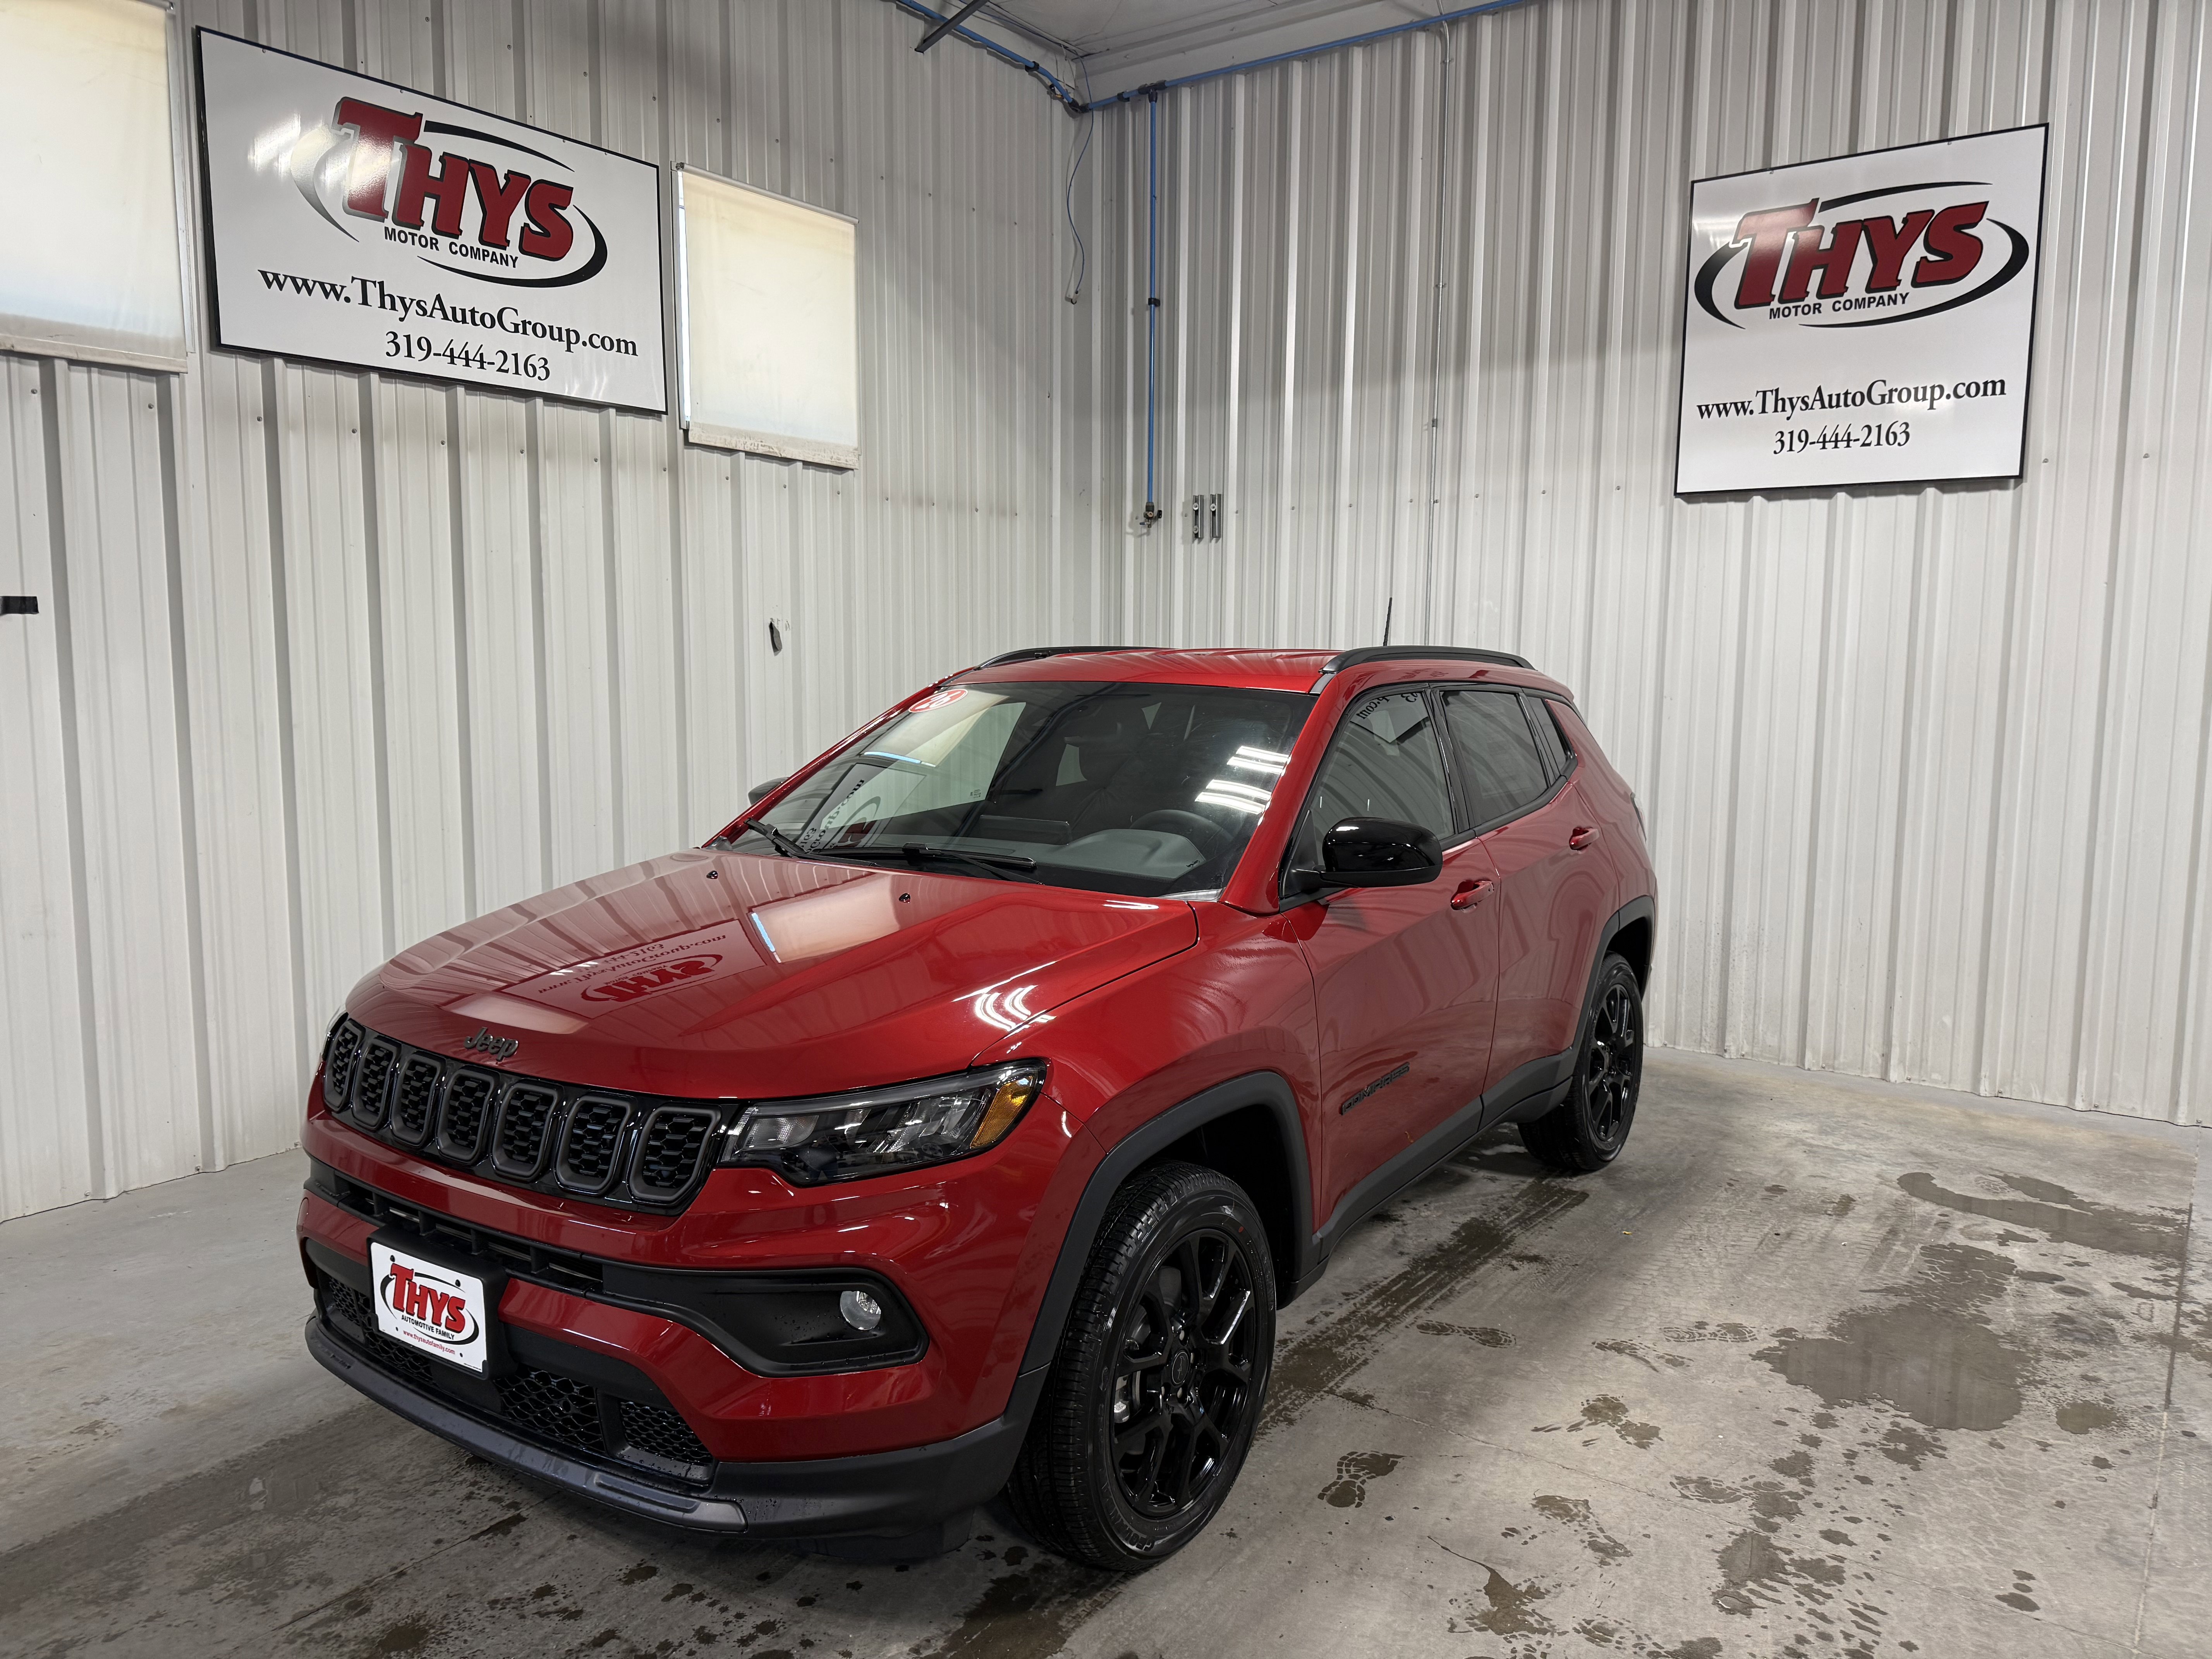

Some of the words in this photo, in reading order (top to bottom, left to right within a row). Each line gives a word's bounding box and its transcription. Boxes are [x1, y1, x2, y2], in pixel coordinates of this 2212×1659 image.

[331, 96, 574, 262] THYS
[384, 226, 439, 251] MOTOR
[449, 241, 519, 269] COMPANY
[1734, 197, 1989, 310] THYS
[258, 269, 639, 356] www.ThysAutoGroup.com
[1769, 303, 1822, 319] MOTOR
[1832, 292, 1910, 313] COMPANY
[385, 331, 551, 381] 319-444-2163
[1697, 377, 2007, 421] www.ThysAutoGroup.com
[1773, 421, 1911, 455] 319-444-2163
[464, 1027, 519, 1061] Jeep
[1341, 1061, 1410, 1115] COMPASS
[390, 1263, 466, 1333] THYS
[402, 1315, 434, 1332] AUTOMOTIVE
[436, 1328, 454, 1340] FAMILY
